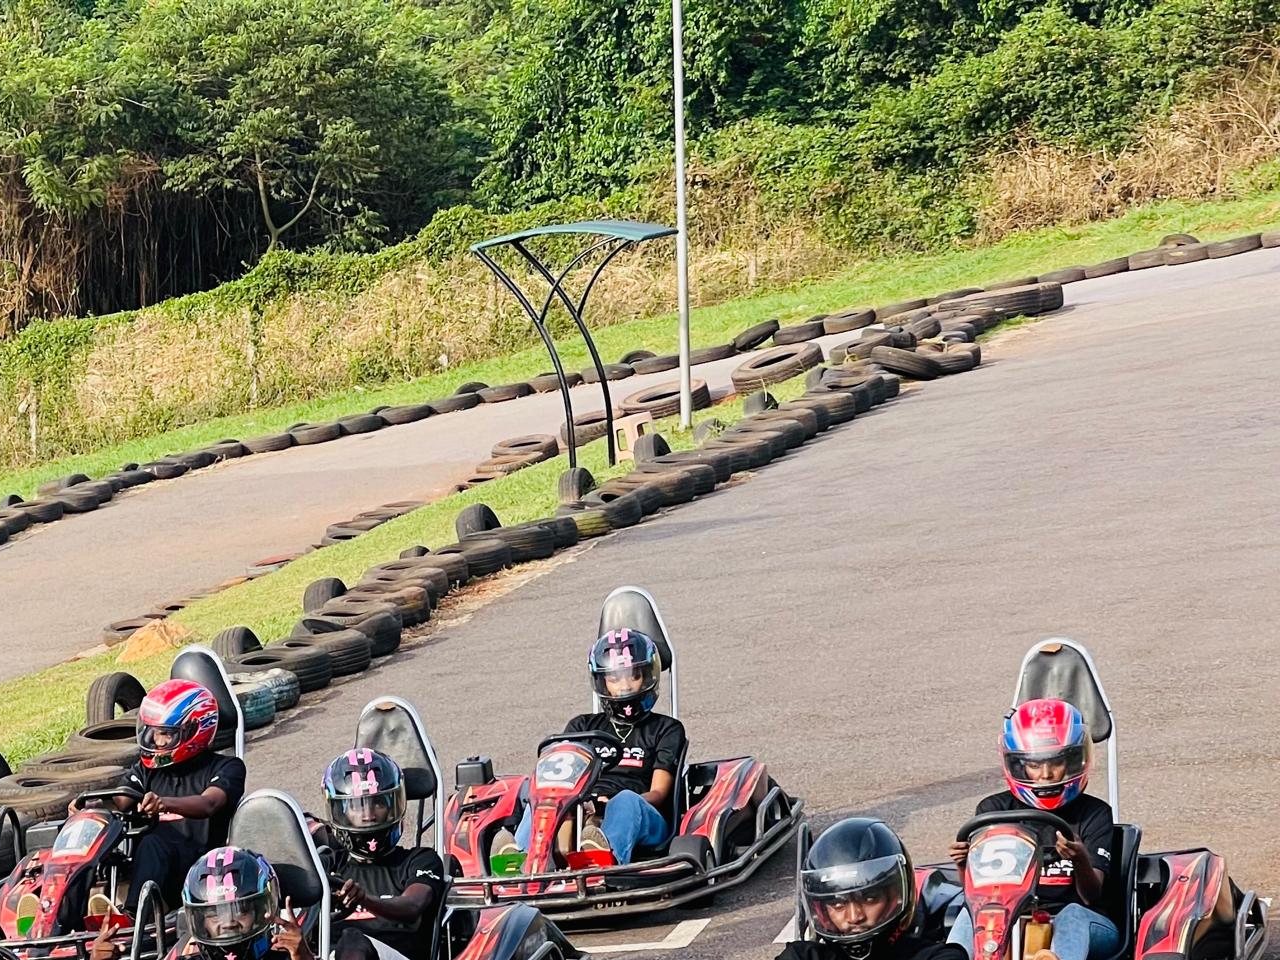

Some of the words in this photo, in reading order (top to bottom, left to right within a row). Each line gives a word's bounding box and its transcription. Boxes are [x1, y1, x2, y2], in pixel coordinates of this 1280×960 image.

[543, 752, 575, 781] 3
[62, 819, 86, 849] 1
[977, 840, 1018, 877] 5
